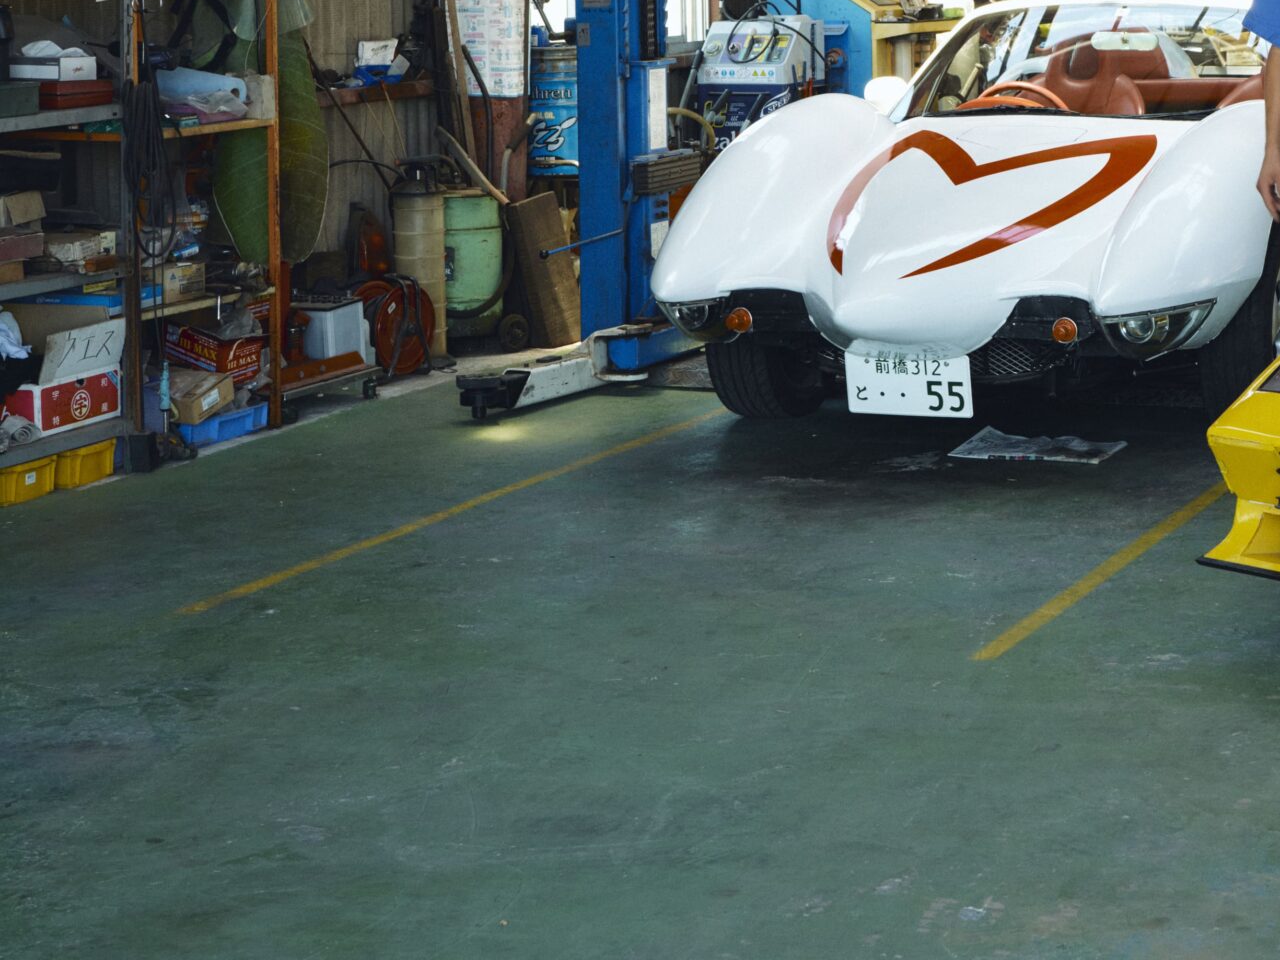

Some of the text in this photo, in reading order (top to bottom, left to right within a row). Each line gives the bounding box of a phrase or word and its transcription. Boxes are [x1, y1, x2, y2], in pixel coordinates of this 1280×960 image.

[193, 342, 217, 361] MAX
[238, 355, 258, 367] MAX
[926, 380, 965, 413] 55
